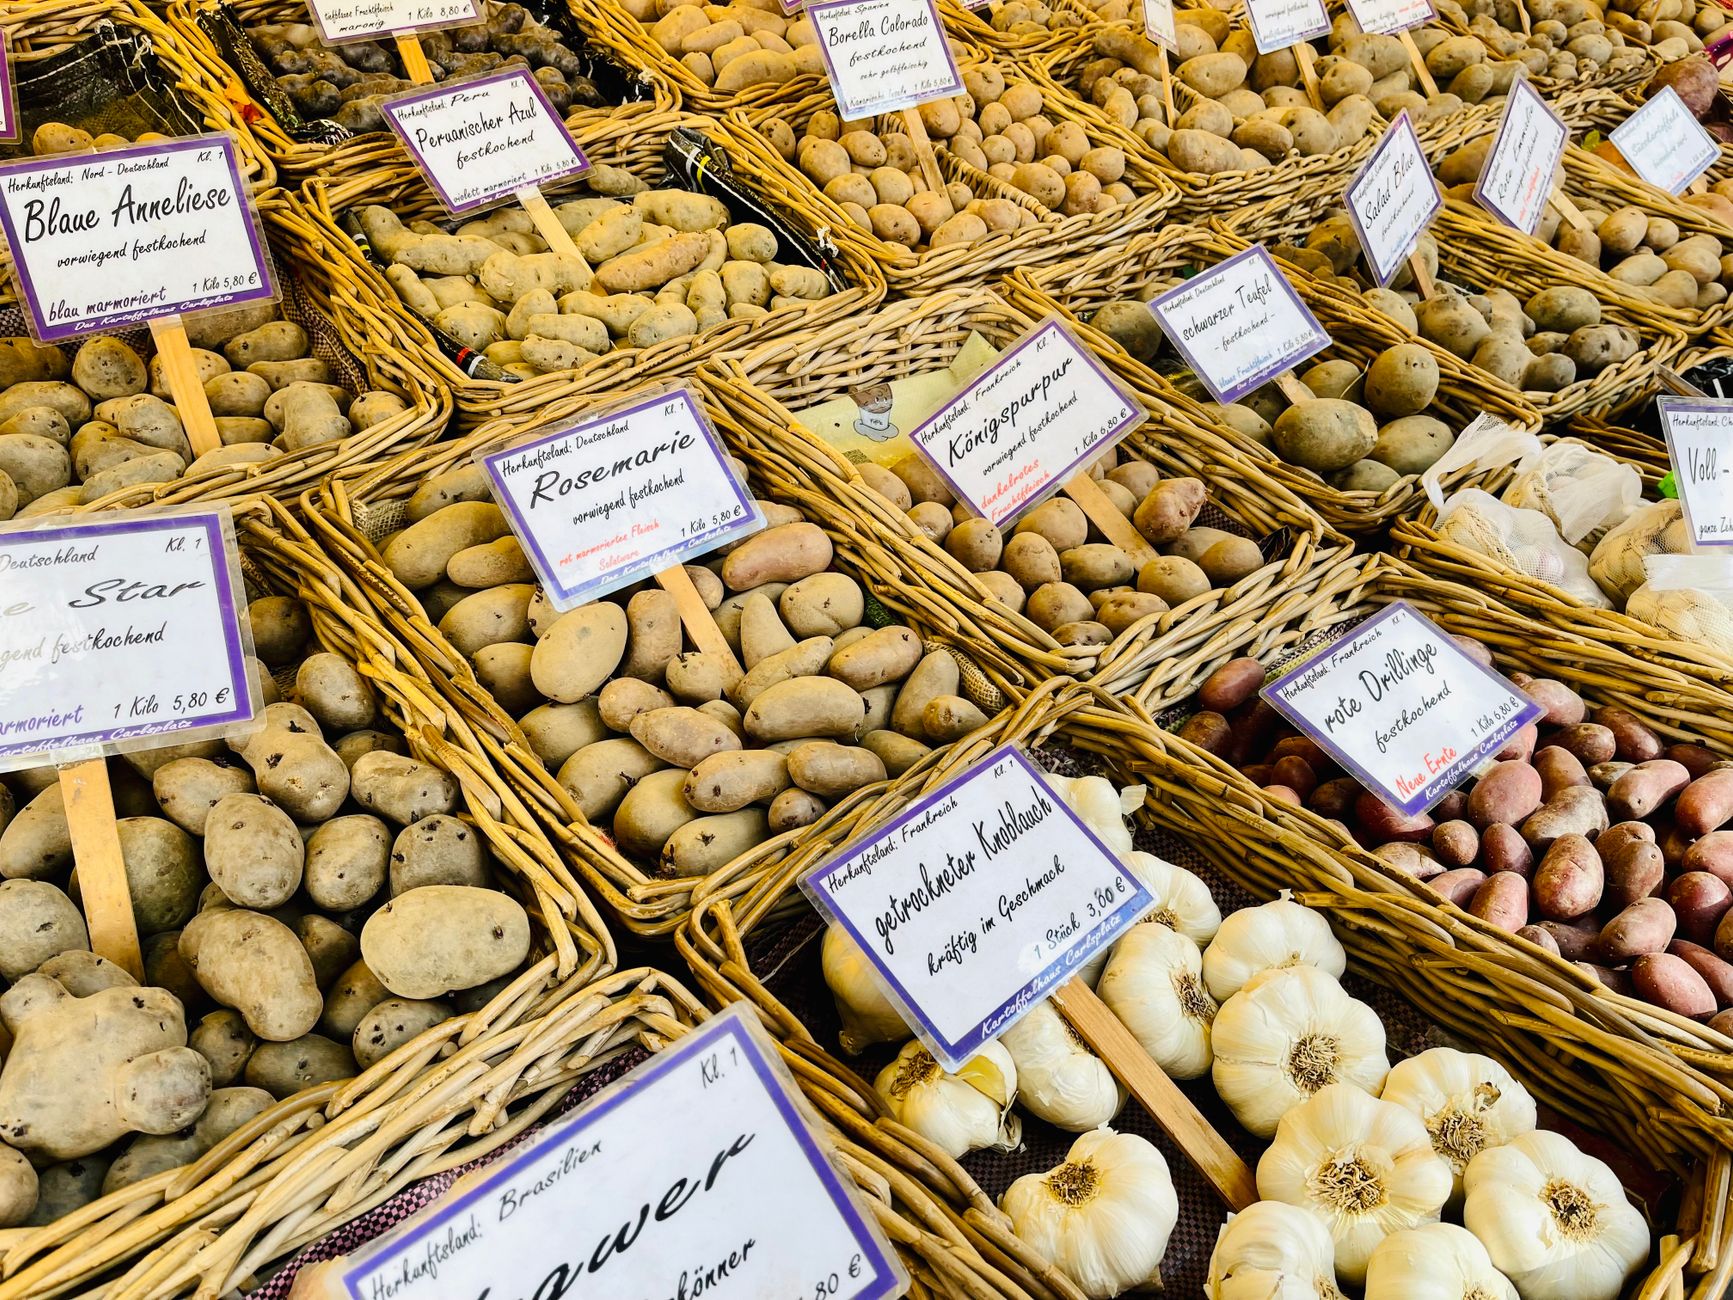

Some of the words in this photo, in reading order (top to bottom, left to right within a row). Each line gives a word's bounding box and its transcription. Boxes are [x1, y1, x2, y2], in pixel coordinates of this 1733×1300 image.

[339, 20, 385, 32] maronig
[408, 11, 412, 20] 1
[417, 8, 433, 19] Kilo
[440, 6, 459, 18] 8,80
[829, 20, 876, 47] Borella
[880, 10, 929, 36] Colorado
[854, 2, 889, 14] Spanien
[849, 37, 928, 68] festkochend
[450, 90, 490, 106] Peru
[416, 112, 504, 152] Peruanischer
[508, 97, 538, 127] Azul
[218, 151, 223, 159] 1
[456, 130, 536, 170] festkochend
[8, 174, 74, 194] Herkunftsland:
[81, 165, 104, 180] Nord
[117, 158, 169, 176] Deutschland
[454, 187, 480, 203] violett
[483, 172, 526, 194] marmoriert
[1365, 176, 1391, 230] Salad
[1393, 153, 1416, 190] Blue
[24, 196, 100, 243] Blaue
[112, 176, 231, 227] Anneliese
[57, 241, 127, 268] vorwiegend
[132, 229, 207, 259] festkochend
[49, 298, 80, 321] blau
[86, 286, 167, 315] marmoriert
[192, 283, 197, 293] 1
[202, 276, 220, 292] Kilo
[223, 274, 245, 291] 5,80
[248, 271, 258, 285] €
[1182, 303, 1235, 341] schwarzer
[1235, 273, 1272, 308] Teufel
[1222, 312, 1269, 352] festkochend
[680, 402, 684, 410] 1
[920, 400, 971, 446] Herkunftsland:
[975, 360, 1022, 401] Frankreich
[949, 356, 1073, 468] Königspurpur
[502, 442, 573, 478] Herkunftsland:
[575, 420, 630, 450] Deutschland
[983, 436, 1027, 476] vorwiegend
[1029, 391, 1078, 442] festkochend
[1074, 447, 1079, 456] 1
[1082, 433, 1098, 450] Kilo
[1100, 416, 1119, 435] 6,80
[1120, 408, 1127, 418] €
[530, 429, 696, 510] Rosemarie
[981, 459, 1040, 510] dunkelrotes
[1688, 447, 1717, 485] Voll
[573, 490, 626, 525] vorwiegend
[629, 468, 685, 509] festkochend
[991, 472, 1051, 521] Fruchtfleisch
[559, 554, 572, 566] rot
[631, 518, 660, 537] Fleisch
[681, 527, 685, 537] 1
[690, 519, 705, 534] Kilo
[712, 510, 731, 526] 5,80
[733, 505, 742, 517] €
[1699, 525, 1718, 539] ganze
[0, 545, 98, 573] Deutschland
[165, 537, 186, 553] Kl.
[195, 538, 201, 549] 1
[68, 577, 207, 610] Star
[51, 620, 168, 664] festkochend
[1331, 628, 1383, 668] Frankreich
[114, 703, 121, 719] 1
[130, 694, 159, 717] Kilo
[172, 691, 208, 714] 5,80
[215, 687, 230, 704] €
[1325, 694, 1362, 734] rote
[1359, 642, 1438, 702] Drillinge
[1375, 680, 1452, 754] festkochend
[1471, 727, 1476, 738] 1
[1478, 715, 1495, 735] Kilo
[1494, 702, 1511, 722] 6,80
[1510, 696, 1519, 708] €
[993, 766, 1007, 779] Kl.
[1009, 760, 1014, 768] 1
[1395, 772, 1426, 800] Neue
[1427, 745, 1457, 774] Ernte
[827, 836, 899, 894] Herkunftsland:
[901, 795, 959, 844] Frankreich
[875, 849, 977, 955] getrockneter
[972, 785, 1052, 861] Knoblauch
[927, 929, 978, 977] kräftig
[981, 916, 997, 935] im
[998, 854, 1065, 923] Geschmack
[1033, 945, 1042, 960] 1
[1045, 912, 1081, 950] Stück
[1115, 876, 1125, 893] €
[981, 964, 1062, 1040] Kartoffelhaus
[1065, 913, 1124, 967] Carlsplatz
[371, 1213, 483, 1300] Herkunftsland:
[499, 1139, 602, 1223] Brasilien
[699, 1054, 726, 1090] Kl.
[730, 1047, 739, 1068] 1
[667, 1238, 756, 1300] könner
[848, 1253, 861, 1278] €
